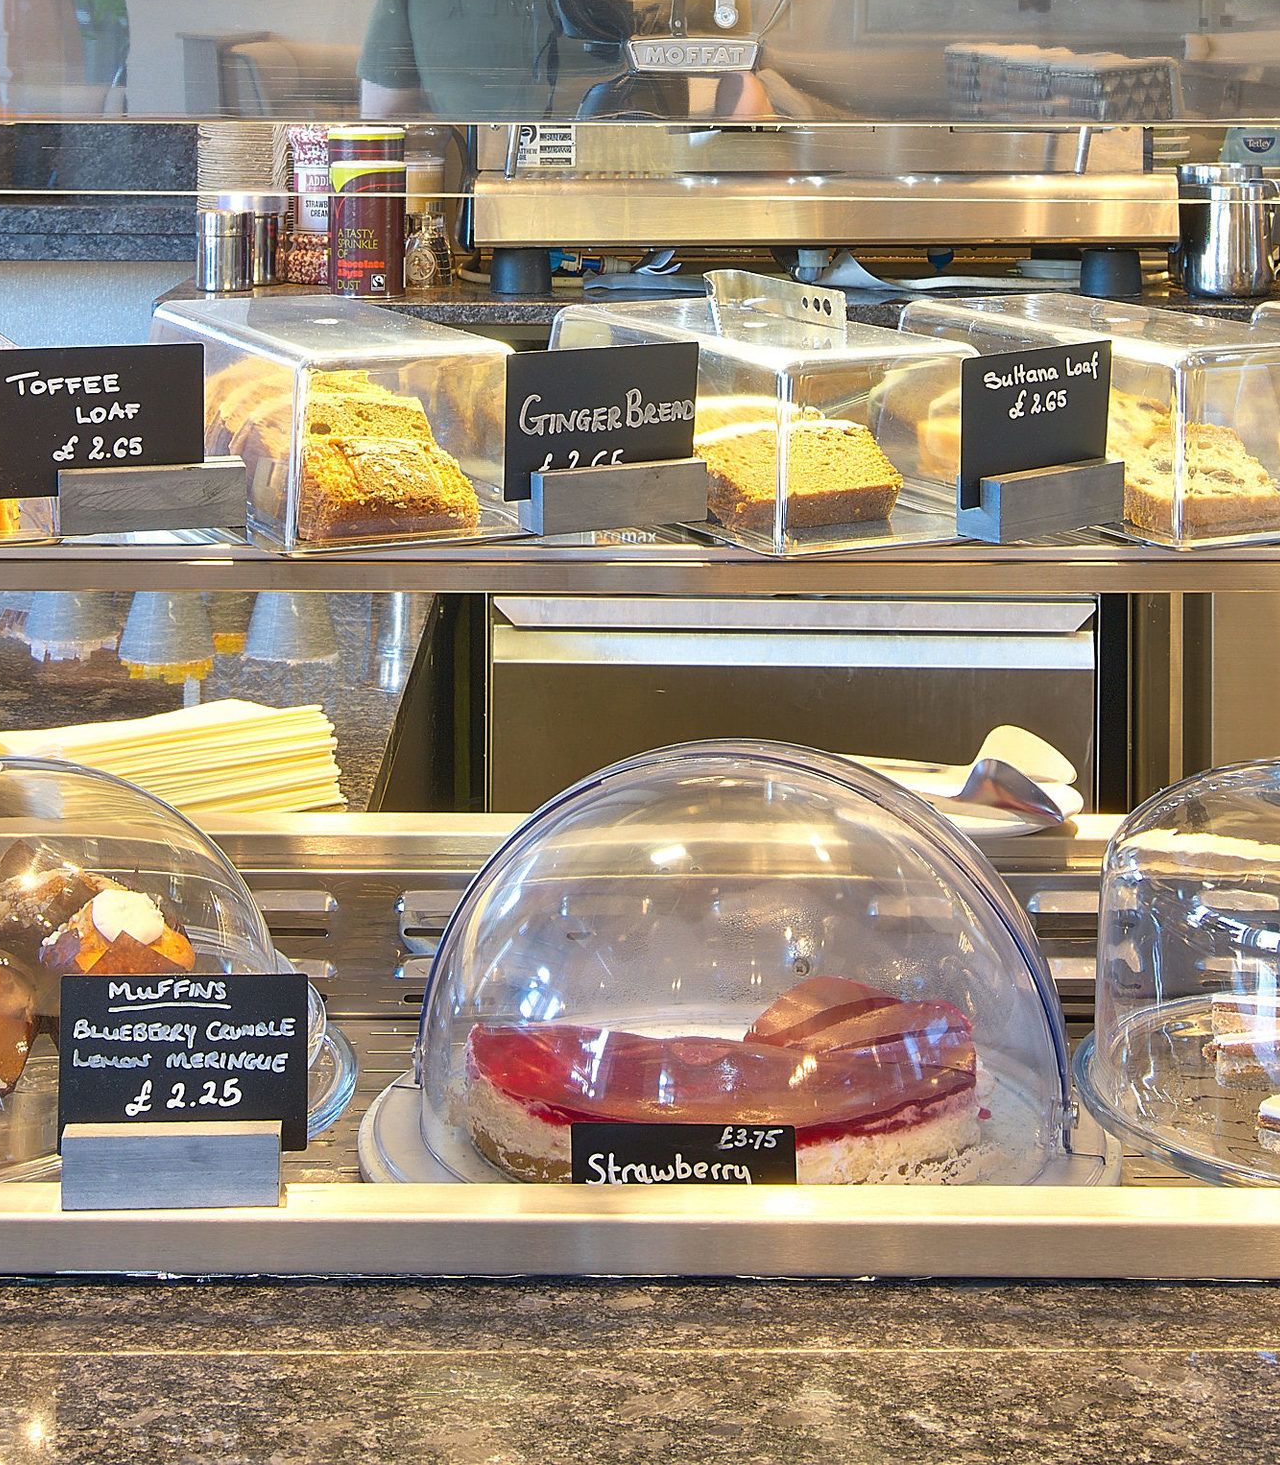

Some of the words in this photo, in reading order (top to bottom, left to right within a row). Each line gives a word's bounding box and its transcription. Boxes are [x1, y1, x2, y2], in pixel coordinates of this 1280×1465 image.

[646, 46, 745, 65] MOFFAT
[1247, 138, 1271, 149] Tetley
[337, 240, 378, 249] SPRINKLE
[345, 229, 375, 237] TASTY
[337, 250, 348, 258] OF
[337, 281, 360, 290] DUST
[982, 362, 1060, 391] Sultana
[1065, 350, 1100, 382] Loaf
[5, 371, 121, 397] TOFFEE
[76, 403, 142, 425] LOAF
[1008, 393, 1026, 420] £
[1031, 390, 1068, 416] 2.65
[51, 435, 76, 462] £
[88, 437, 144, 462] 2.65
[73, 1018, 197, 1044] BLUEBERRY
[72, 1048, 150, 1069] LEMON
[166, 1050, 290, 1073] MERINGUE
[125, 1079, 153, 1117] £
[166, 1077, 243, 1109] 2.25
[586, 1153, 752, 1185] Strawberry
